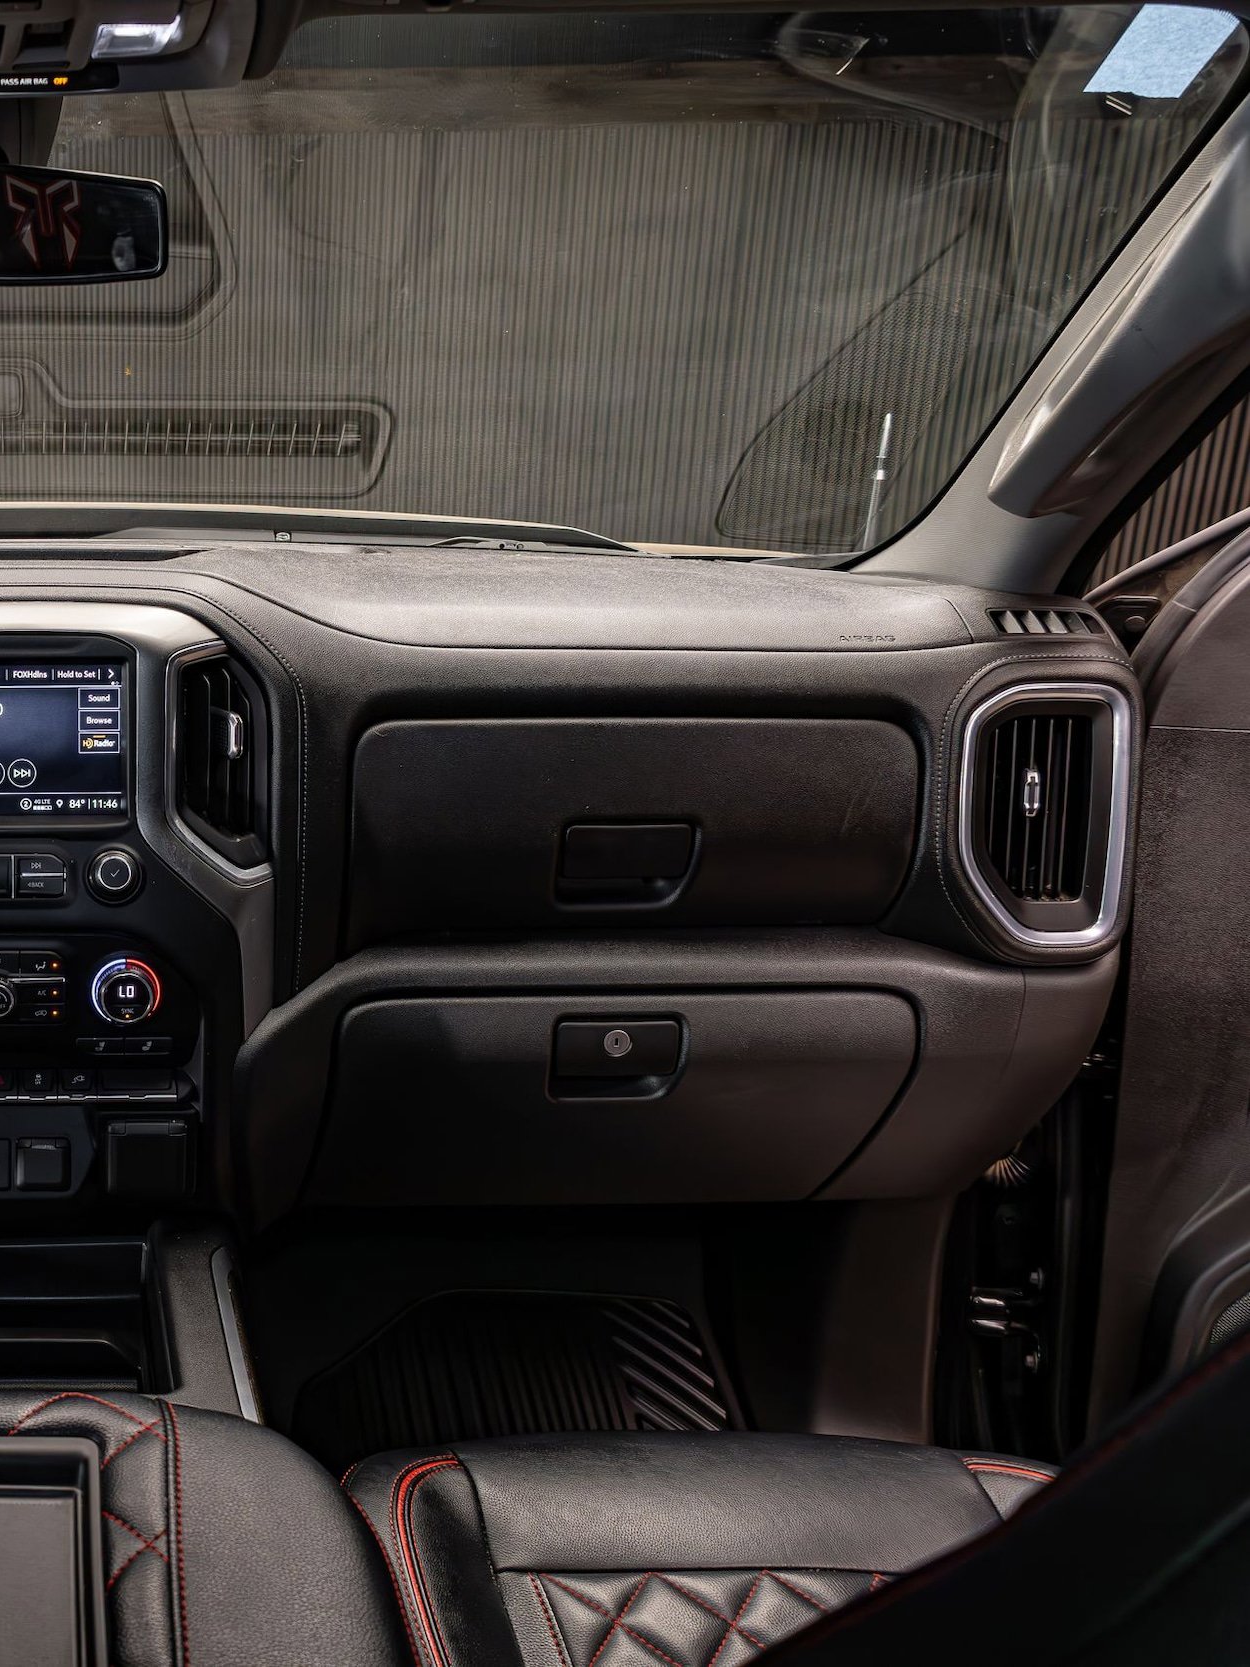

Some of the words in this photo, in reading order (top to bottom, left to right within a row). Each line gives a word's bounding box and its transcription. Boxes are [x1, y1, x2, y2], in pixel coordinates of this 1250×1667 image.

[0, 78, 19, 86] PASS
[20, 77, 32, 85] AIR
[33, 77, 49, 85] BAG
[53, 77, 68, 85] OFF
[57, 670, 74, 679] Hold
[75, 670, 83, 679] to
[84, 670, 96, 679] Set
[88, 694, 111, 703] Sound
[86, 716, 112, 725] Browse
[92, 799, 118, 809] 11:46
[118, 985, 135, 998] LO
